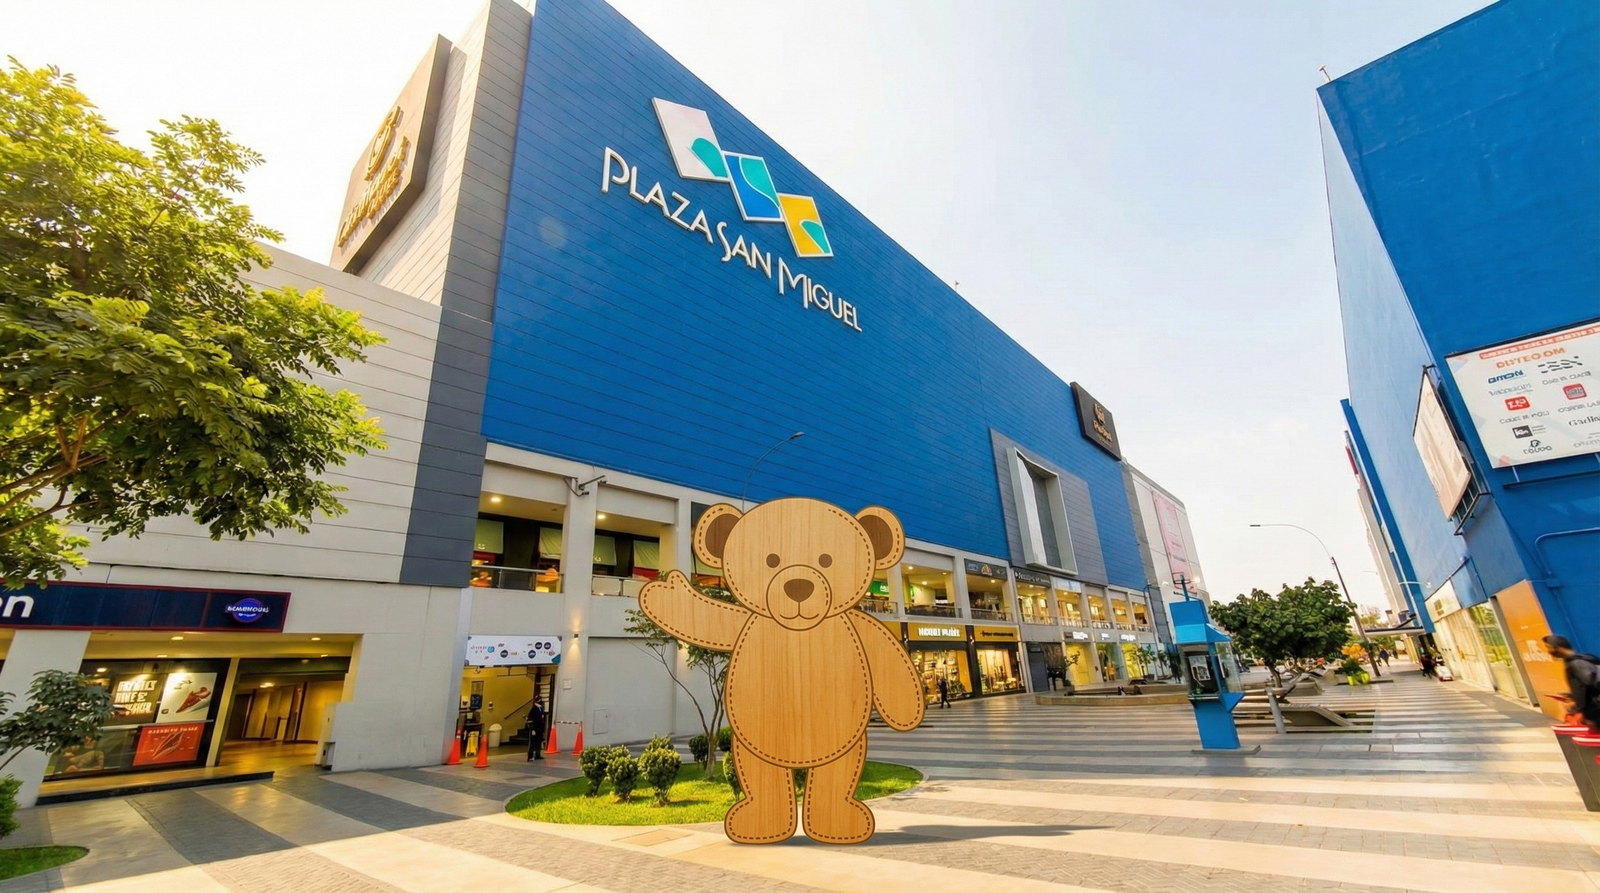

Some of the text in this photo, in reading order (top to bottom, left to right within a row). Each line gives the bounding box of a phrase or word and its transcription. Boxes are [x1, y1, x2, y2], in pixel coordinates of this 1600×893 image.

[601, 146, 863, 333] PLAZA SAN MIGUEL
[0, 595, 35, 618] n
